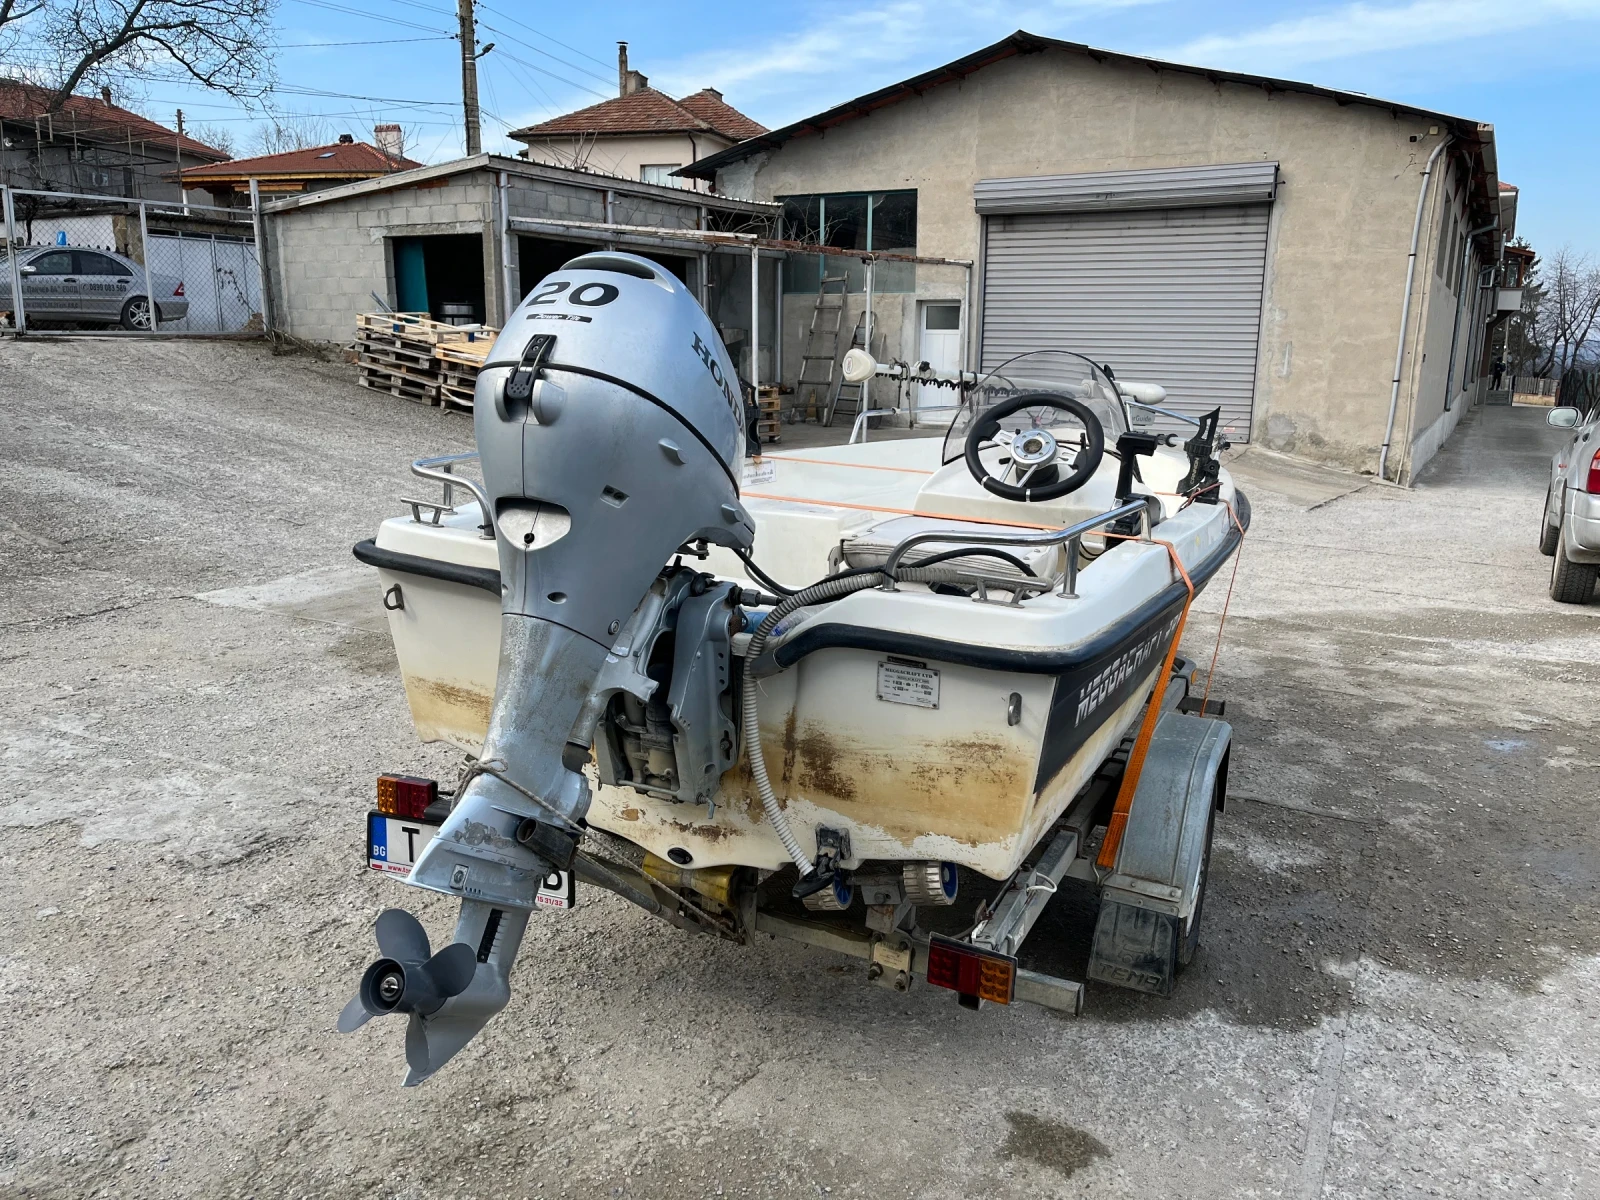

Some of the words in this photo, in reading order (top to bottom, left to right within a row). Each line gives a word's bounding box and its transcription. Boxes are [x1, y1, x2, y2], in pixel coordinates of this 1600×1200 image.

[525, 281, 620, 307] 20
[373, 845, 386, 857] BG
[401, 826, 420, 862] T
[544, 897, 563, 907] 31/32
[1100, 962, 1162, 987] TEMA
